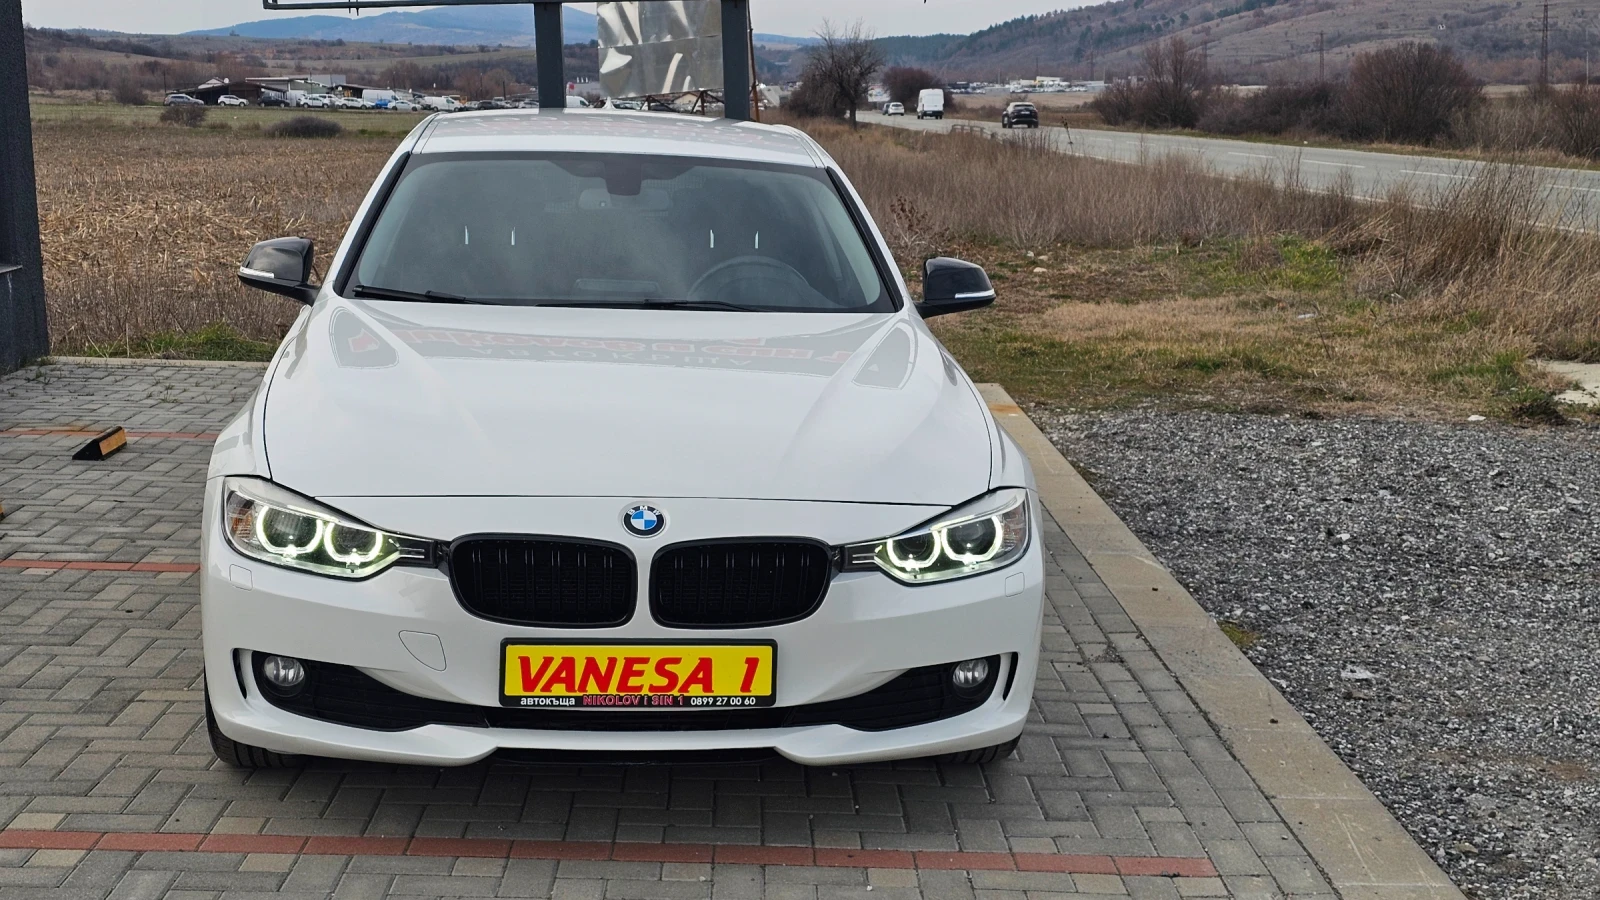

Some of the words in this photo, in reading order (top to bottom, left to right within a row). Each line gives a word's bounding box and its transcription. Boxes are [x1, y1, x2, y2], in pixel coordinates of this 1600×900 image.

[518, 656, 714, 693] VANESA
[740, 657, 760, 693] 1
[520, 697, 575, 706] автокъща
[583, 695, 640, 706] NIKOLOV
[651, 695, 674, 706] SIN
[677, 695, 684, 706] 1
[690, 697, 714, 706] 0899
[716, 697, 728, 706] 27
[730, 697, 742, 706] 00
[744, 697, 756, 706] 60
